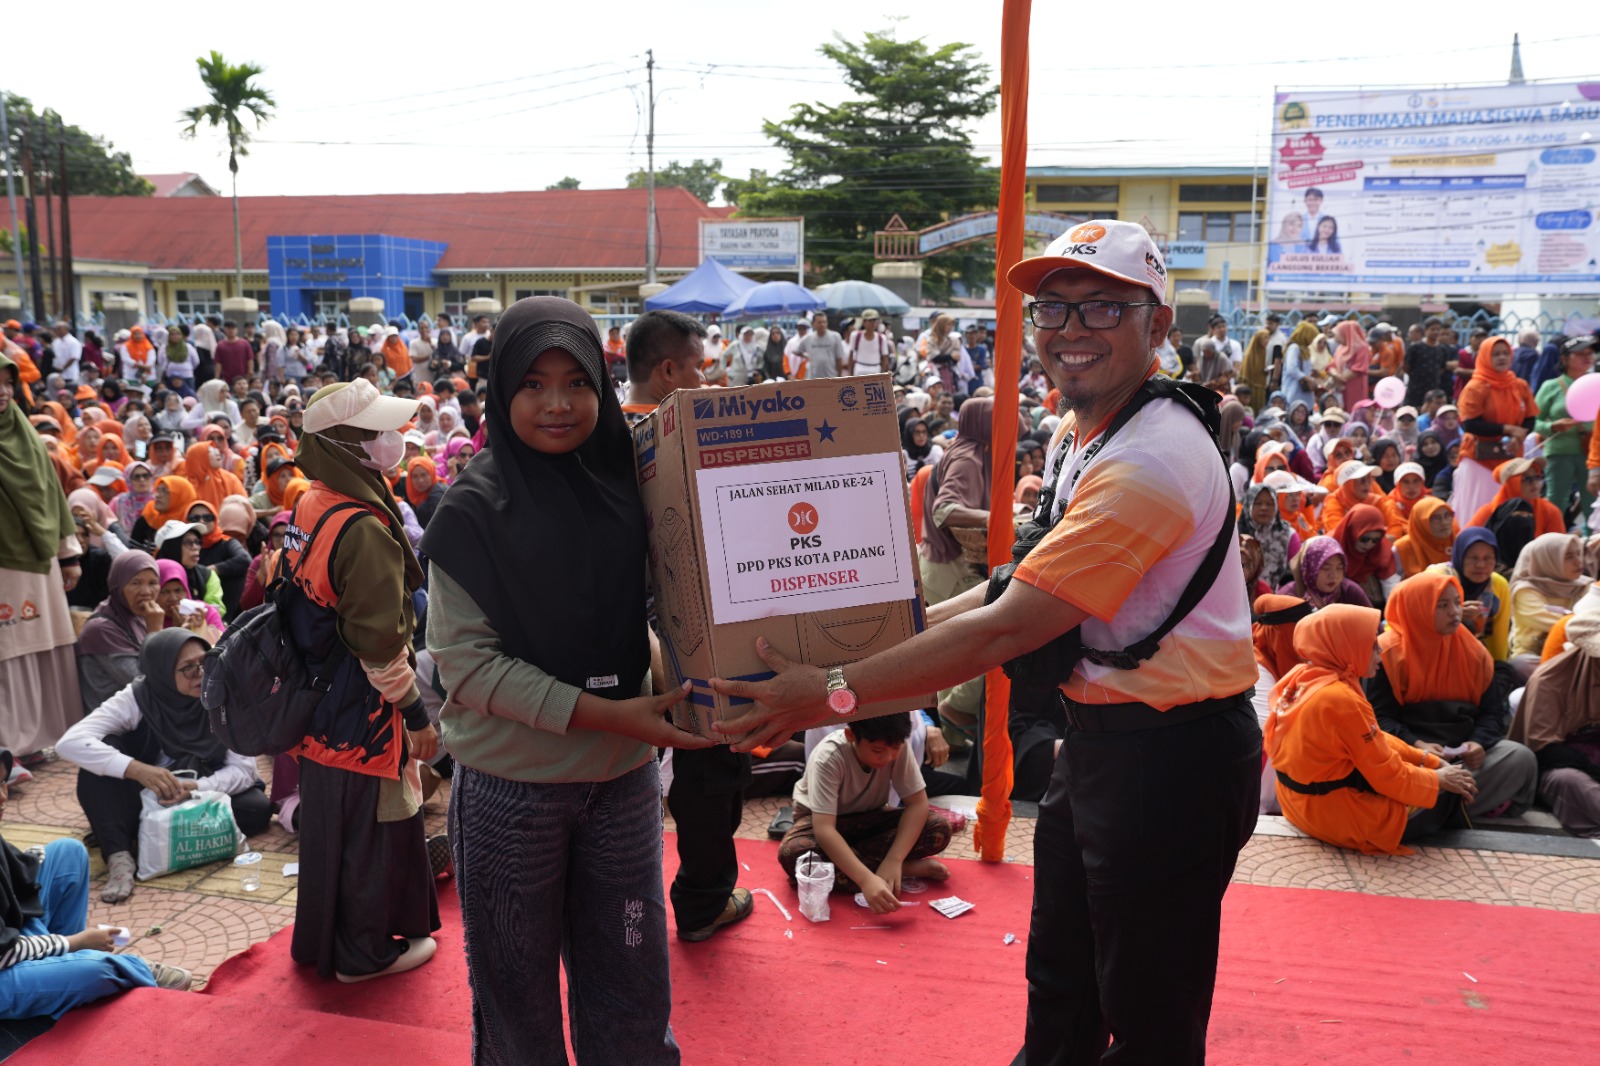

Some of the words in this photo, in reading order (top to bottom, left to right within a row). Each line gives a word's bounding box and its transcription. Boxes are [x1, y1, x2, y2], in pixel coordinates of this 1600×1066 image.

[1315, 112, 1426, 129] PENERIMAAN
[1431, 108, 1545, 125] MAHASISWA
[1550, 104, 1600, 122] BARU
[1334, 136, 1390, 149] AKADEMI
[1394, 134, 1449, 148] FARMASI
[1454, 133, 1511, 146] PRAYOGA
[1516, 131, 1567, 144] PADANG
[720, 227, 748, 238] YAYASAN
[749, 227, 779, 238] PRAYOGA
[1062, 244, 1098, 256] PKS
[719, 391, 805, 420] Miyako
[700, 428, 743, 443] WD-189
[745, 427, 754, 437] H
[703, 443, 809, 465] DISPENSER
[729, 487, 765, 501] JALAN
[766, 483, 802, 497] SEHAT
[804, 479, 840, 493] MILAD
[843, 475, 874, 489] KE-24
[790, 534, 822, 550] PKS
[737, 559, 765, 574] DPD
[768, 556, 792, 570] PKS
[794, 550, 830, 566] KOTA
[833, 545, 886, 562] PADANG
[770, 568, 860, 594] DISPENSER
[176, 841, 193, 853] AL
[196, 833, 233, 851] HAKIM
